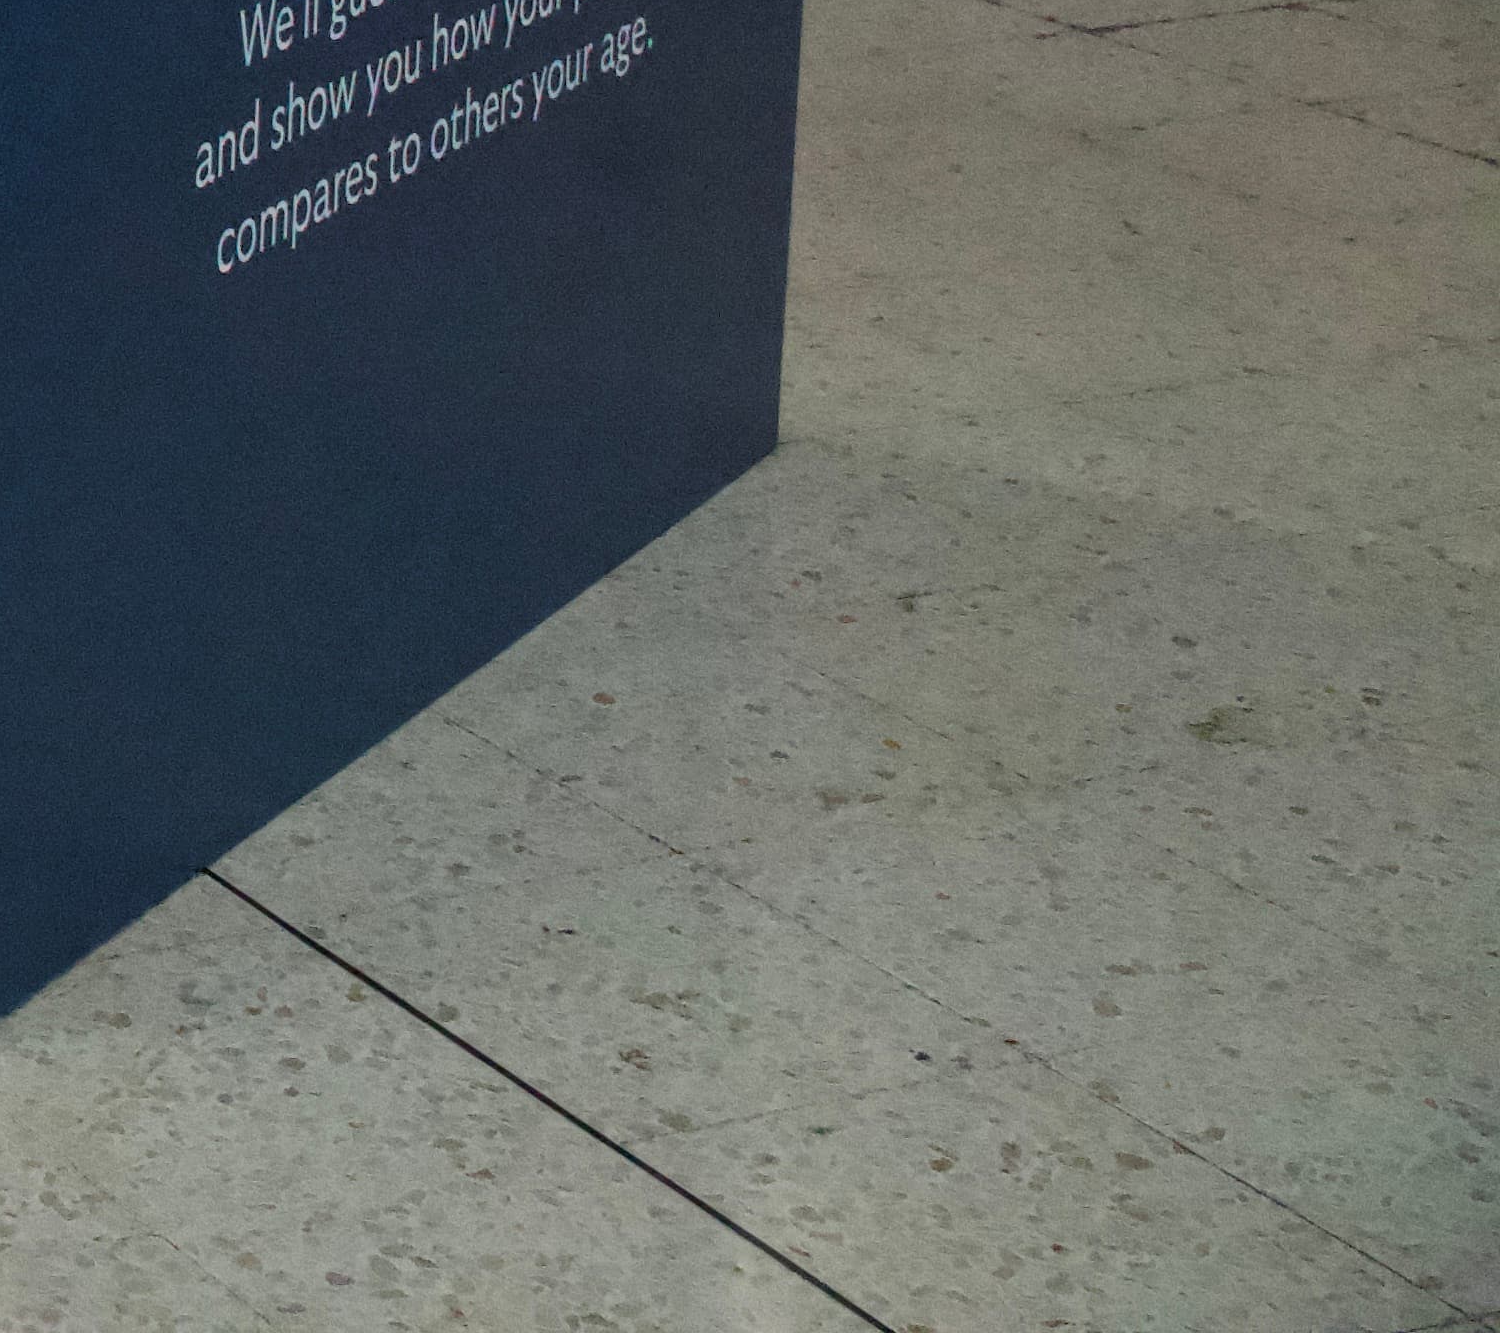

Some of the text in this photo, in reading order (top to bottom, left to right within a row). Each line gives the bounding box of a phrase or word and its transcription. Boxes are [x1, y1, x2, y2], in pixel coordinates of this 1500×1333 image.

[194, 97, 261, 190] and
[269, 64, 357, 153] show
[364, 38, 422, 117] you
[431, 2, 497, 72] how
[216, 11, 655, 275] compares to others your age.
